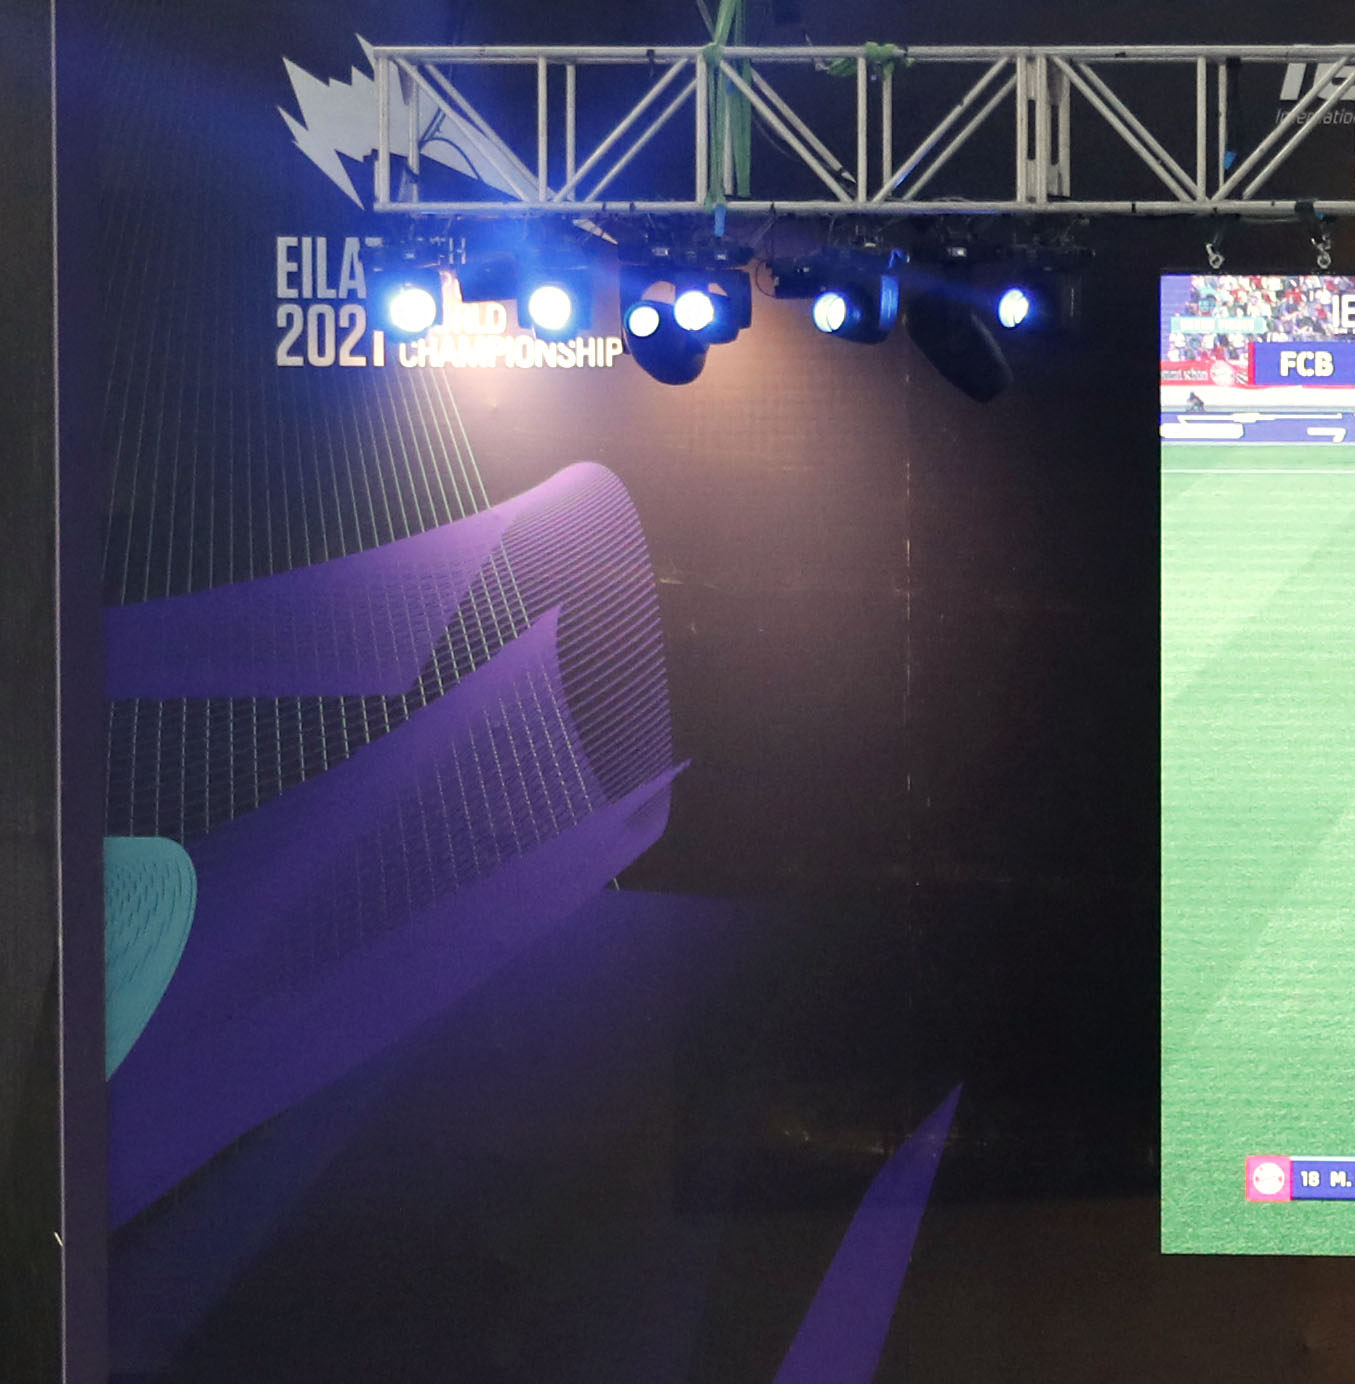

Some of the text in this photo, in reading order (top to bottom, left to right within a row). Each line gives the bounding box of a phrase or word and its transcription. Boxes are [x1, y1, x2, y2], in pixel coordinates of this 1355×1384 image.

[1280, 350, 1335, 379] FCB
[1300, 1170, 1321, 1188] 18
[1329, 1170, 1353, 1188] M.
